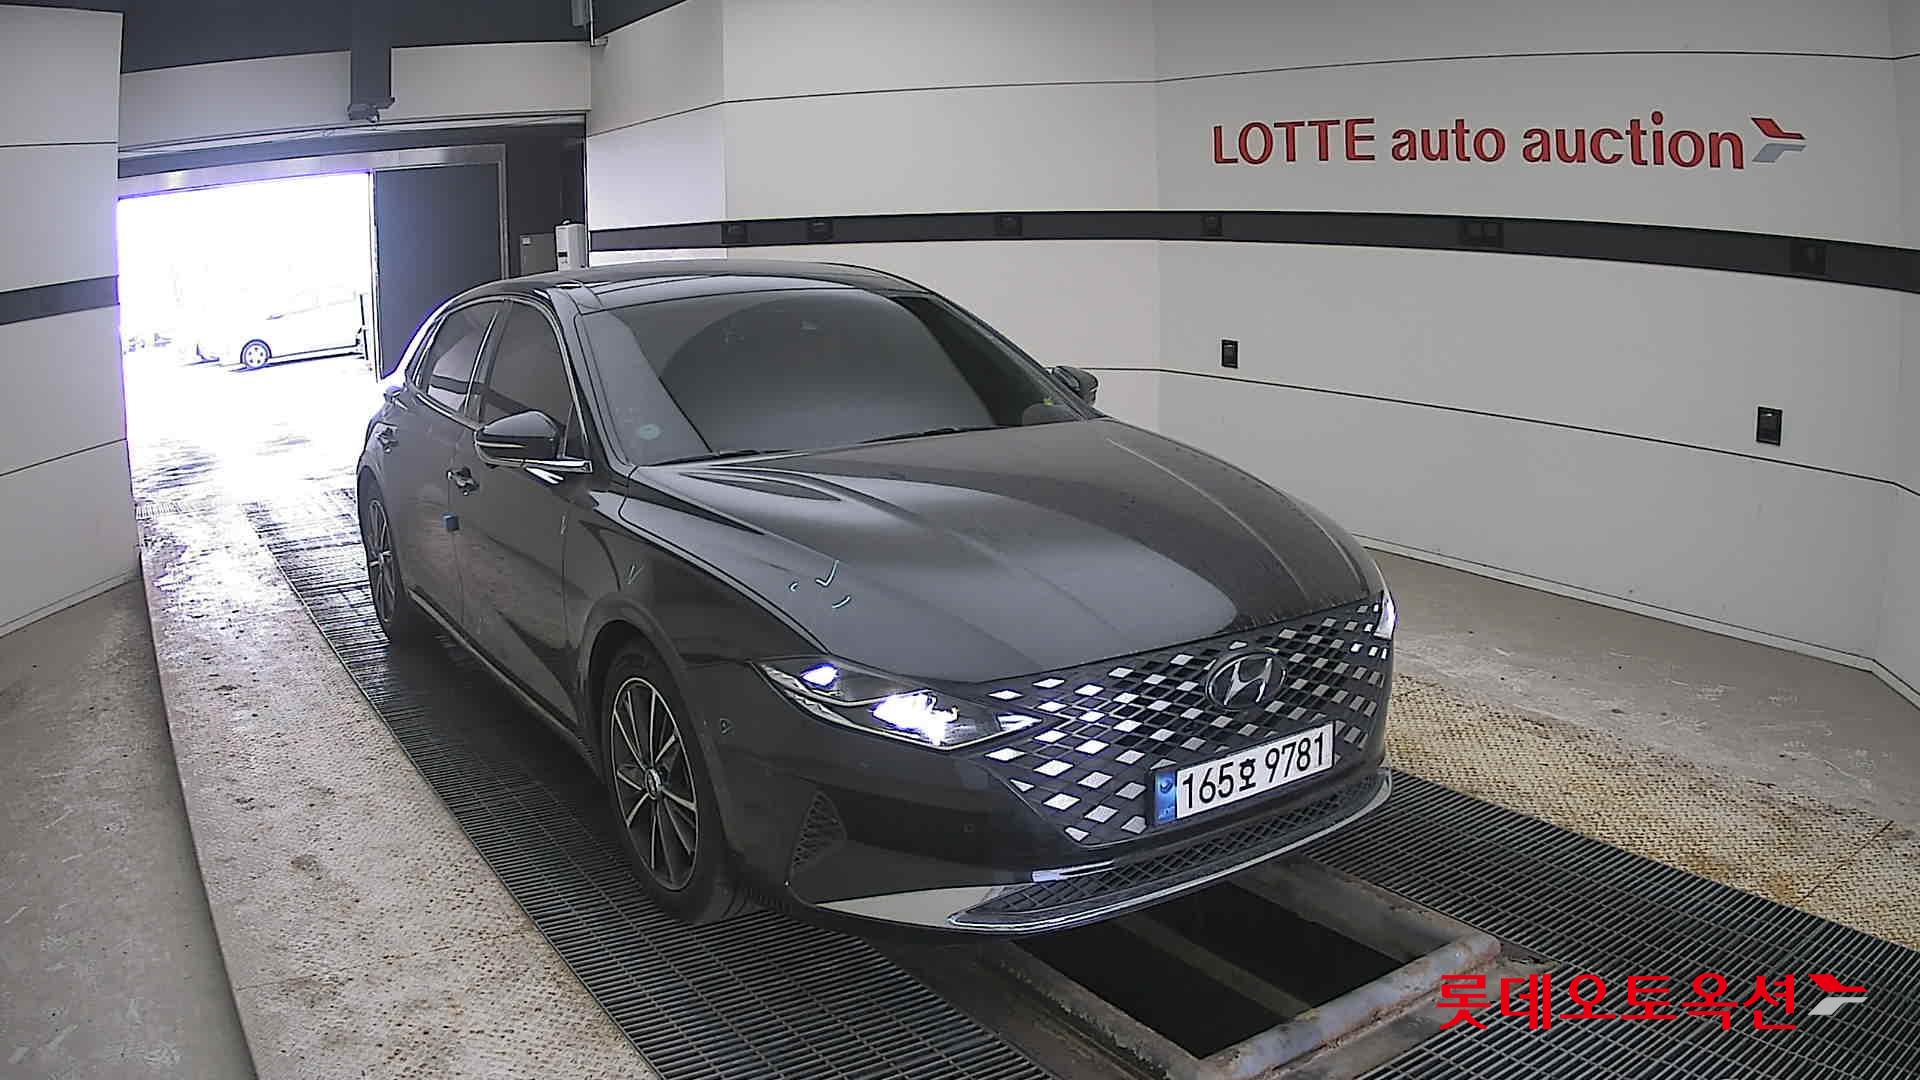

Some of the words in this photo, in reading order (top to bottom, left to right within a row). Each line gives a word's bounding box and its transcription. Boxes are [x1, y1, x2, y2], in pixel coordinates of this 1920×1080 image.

[1213, 118, 1375, 164] LOTTE
[1391, 118, 1505, 162] auto
[1522, 111, 1744, 169] auction
[1264, 731, 1325, 783] 9781
